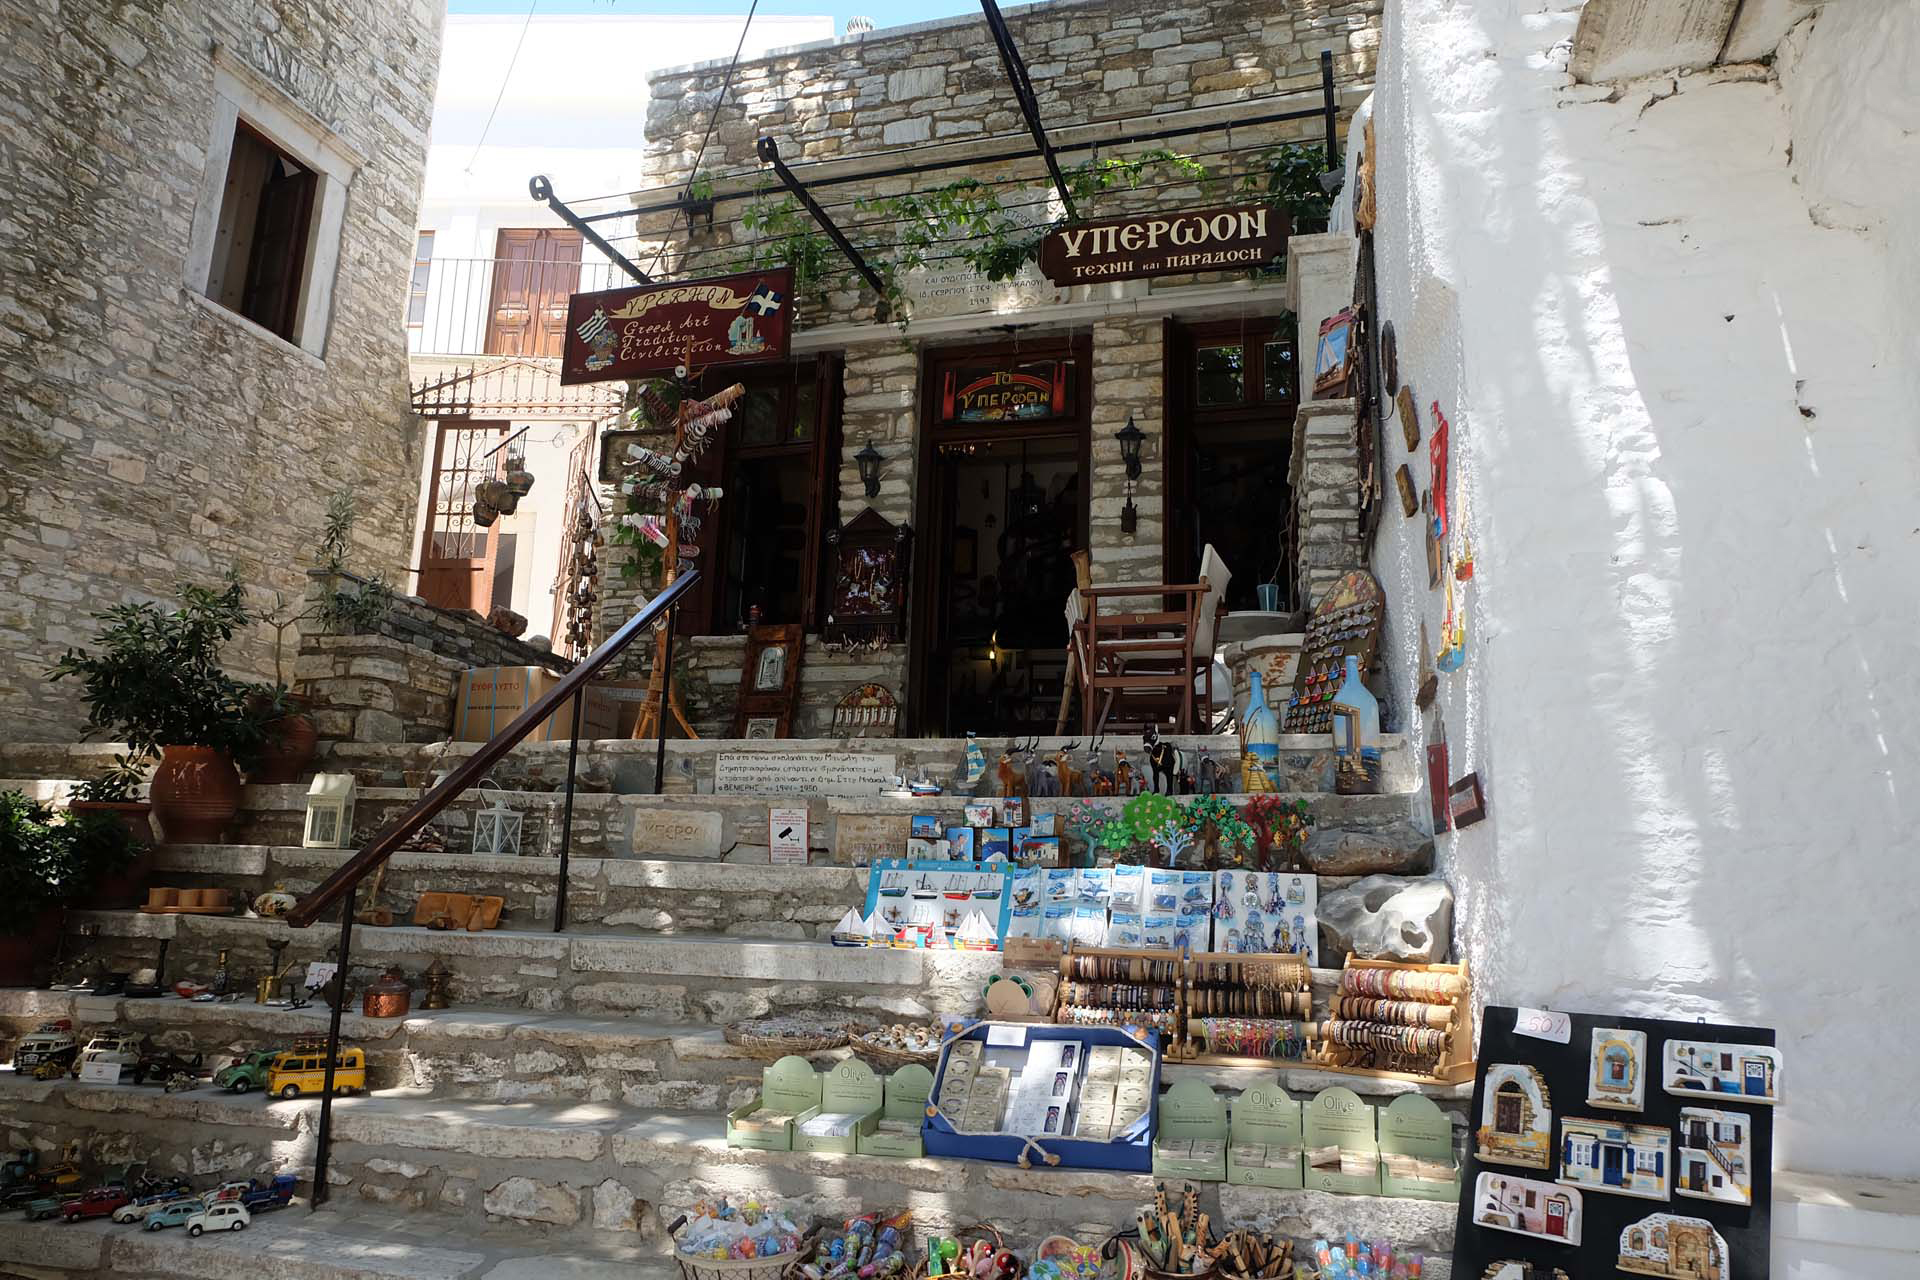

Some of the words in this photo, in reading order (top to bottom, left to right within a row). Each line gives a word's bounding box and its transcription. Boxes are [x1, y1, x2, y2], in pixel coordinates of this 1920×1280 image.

[1073, 260, 1133, 278] ΤΕΧΝΗ
[925, 277, 938, 285] ΚΑΙ
[624, 321, 672, 336] Greek
[680, 313, 711, 329] Art
[622, 331, 696, 348] Tradition
[620, 342, 722, 361] Civilization
[840, 1066, 867, 1082] Olive
[1251, 1090, 1282, 1108] Olive
[1323, 1095, 1355, 1113] Olive
